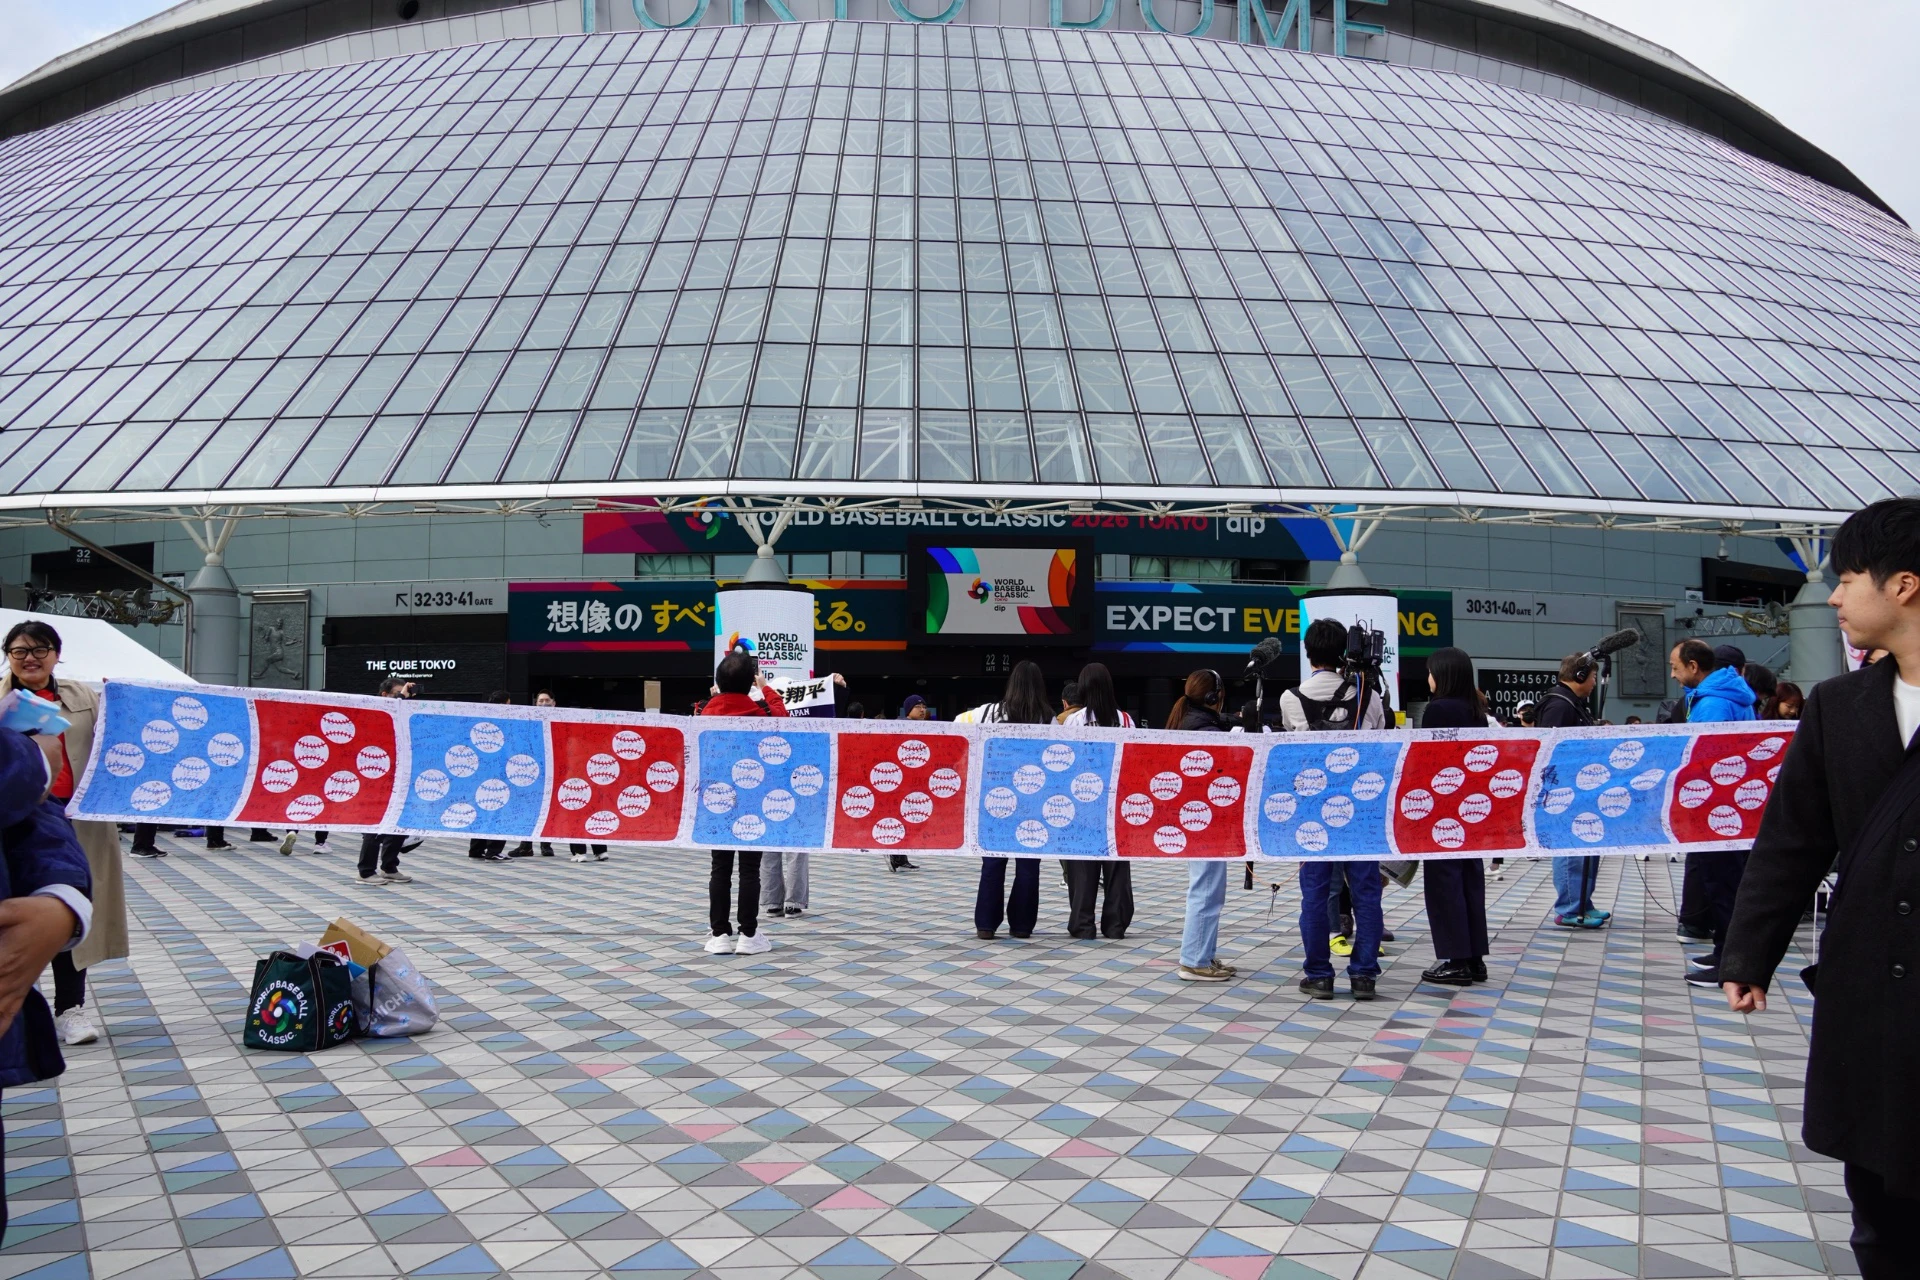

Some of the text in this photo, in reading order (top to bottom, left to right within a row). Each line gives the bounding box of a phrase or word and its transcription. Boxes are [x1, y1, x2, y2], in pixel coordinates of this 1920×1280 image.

[738, 512, 824, 526] OLD
[830, 511, 957, 526] BASEBALL
[962, 512, 1066, 527] CLASSIC
[1071, 514, 1129, 528] 2026
[76, 549, 90, 558] 32
[1516, 608, 1531, 616] GATE
[1106, 605, 1235, 632] EXPECT
[758, 632, 798, 642] WORLD
[758, 642, 808, 653] BASEBALL
[758, 651, 803, 661] CLASSIC
[985, 654, 996, 665] 22
[366, 660, 456, 671] THE CUBE TOKYO
[776, 680, 826, 705] 翔平
[788, 708, 810, 717] APAN
[253, 980, 308, 1019] WORLD BASEBALL
[259, 1029, 295, 1044] CLASSIC
